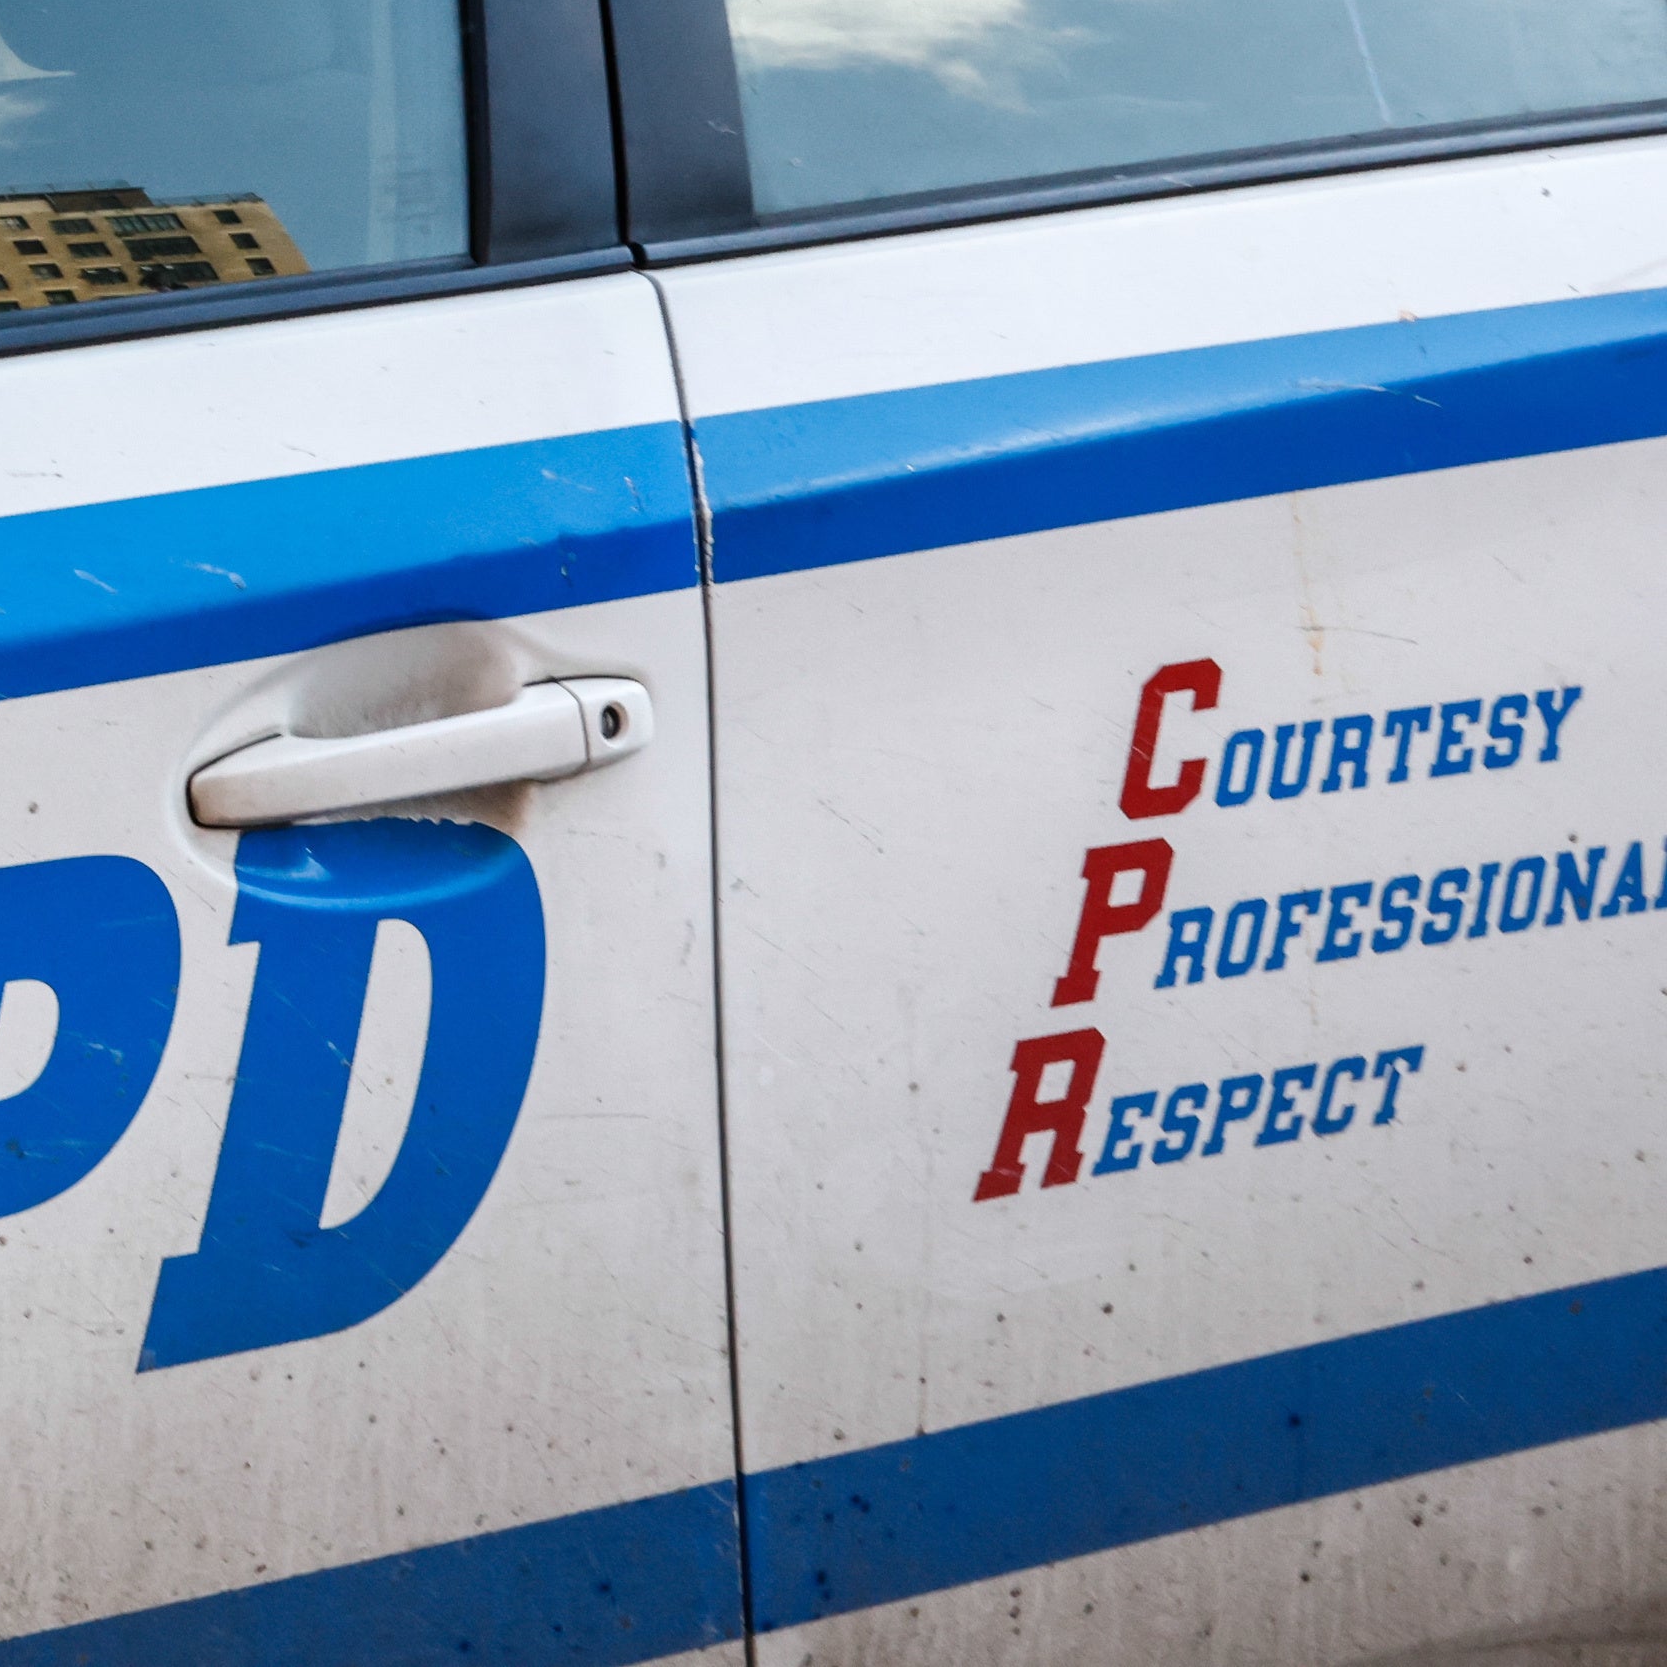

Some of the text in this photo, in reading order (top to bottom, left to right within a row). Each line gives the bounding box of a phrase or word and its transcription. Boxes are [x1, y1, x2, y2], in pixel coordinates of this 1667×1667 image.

[1118, 657, 1584, 820] COURTESY
[1050, 833, 1667, 1008] PROFESSIONA
[972, 1026, 1426, 1203] RESPECT
